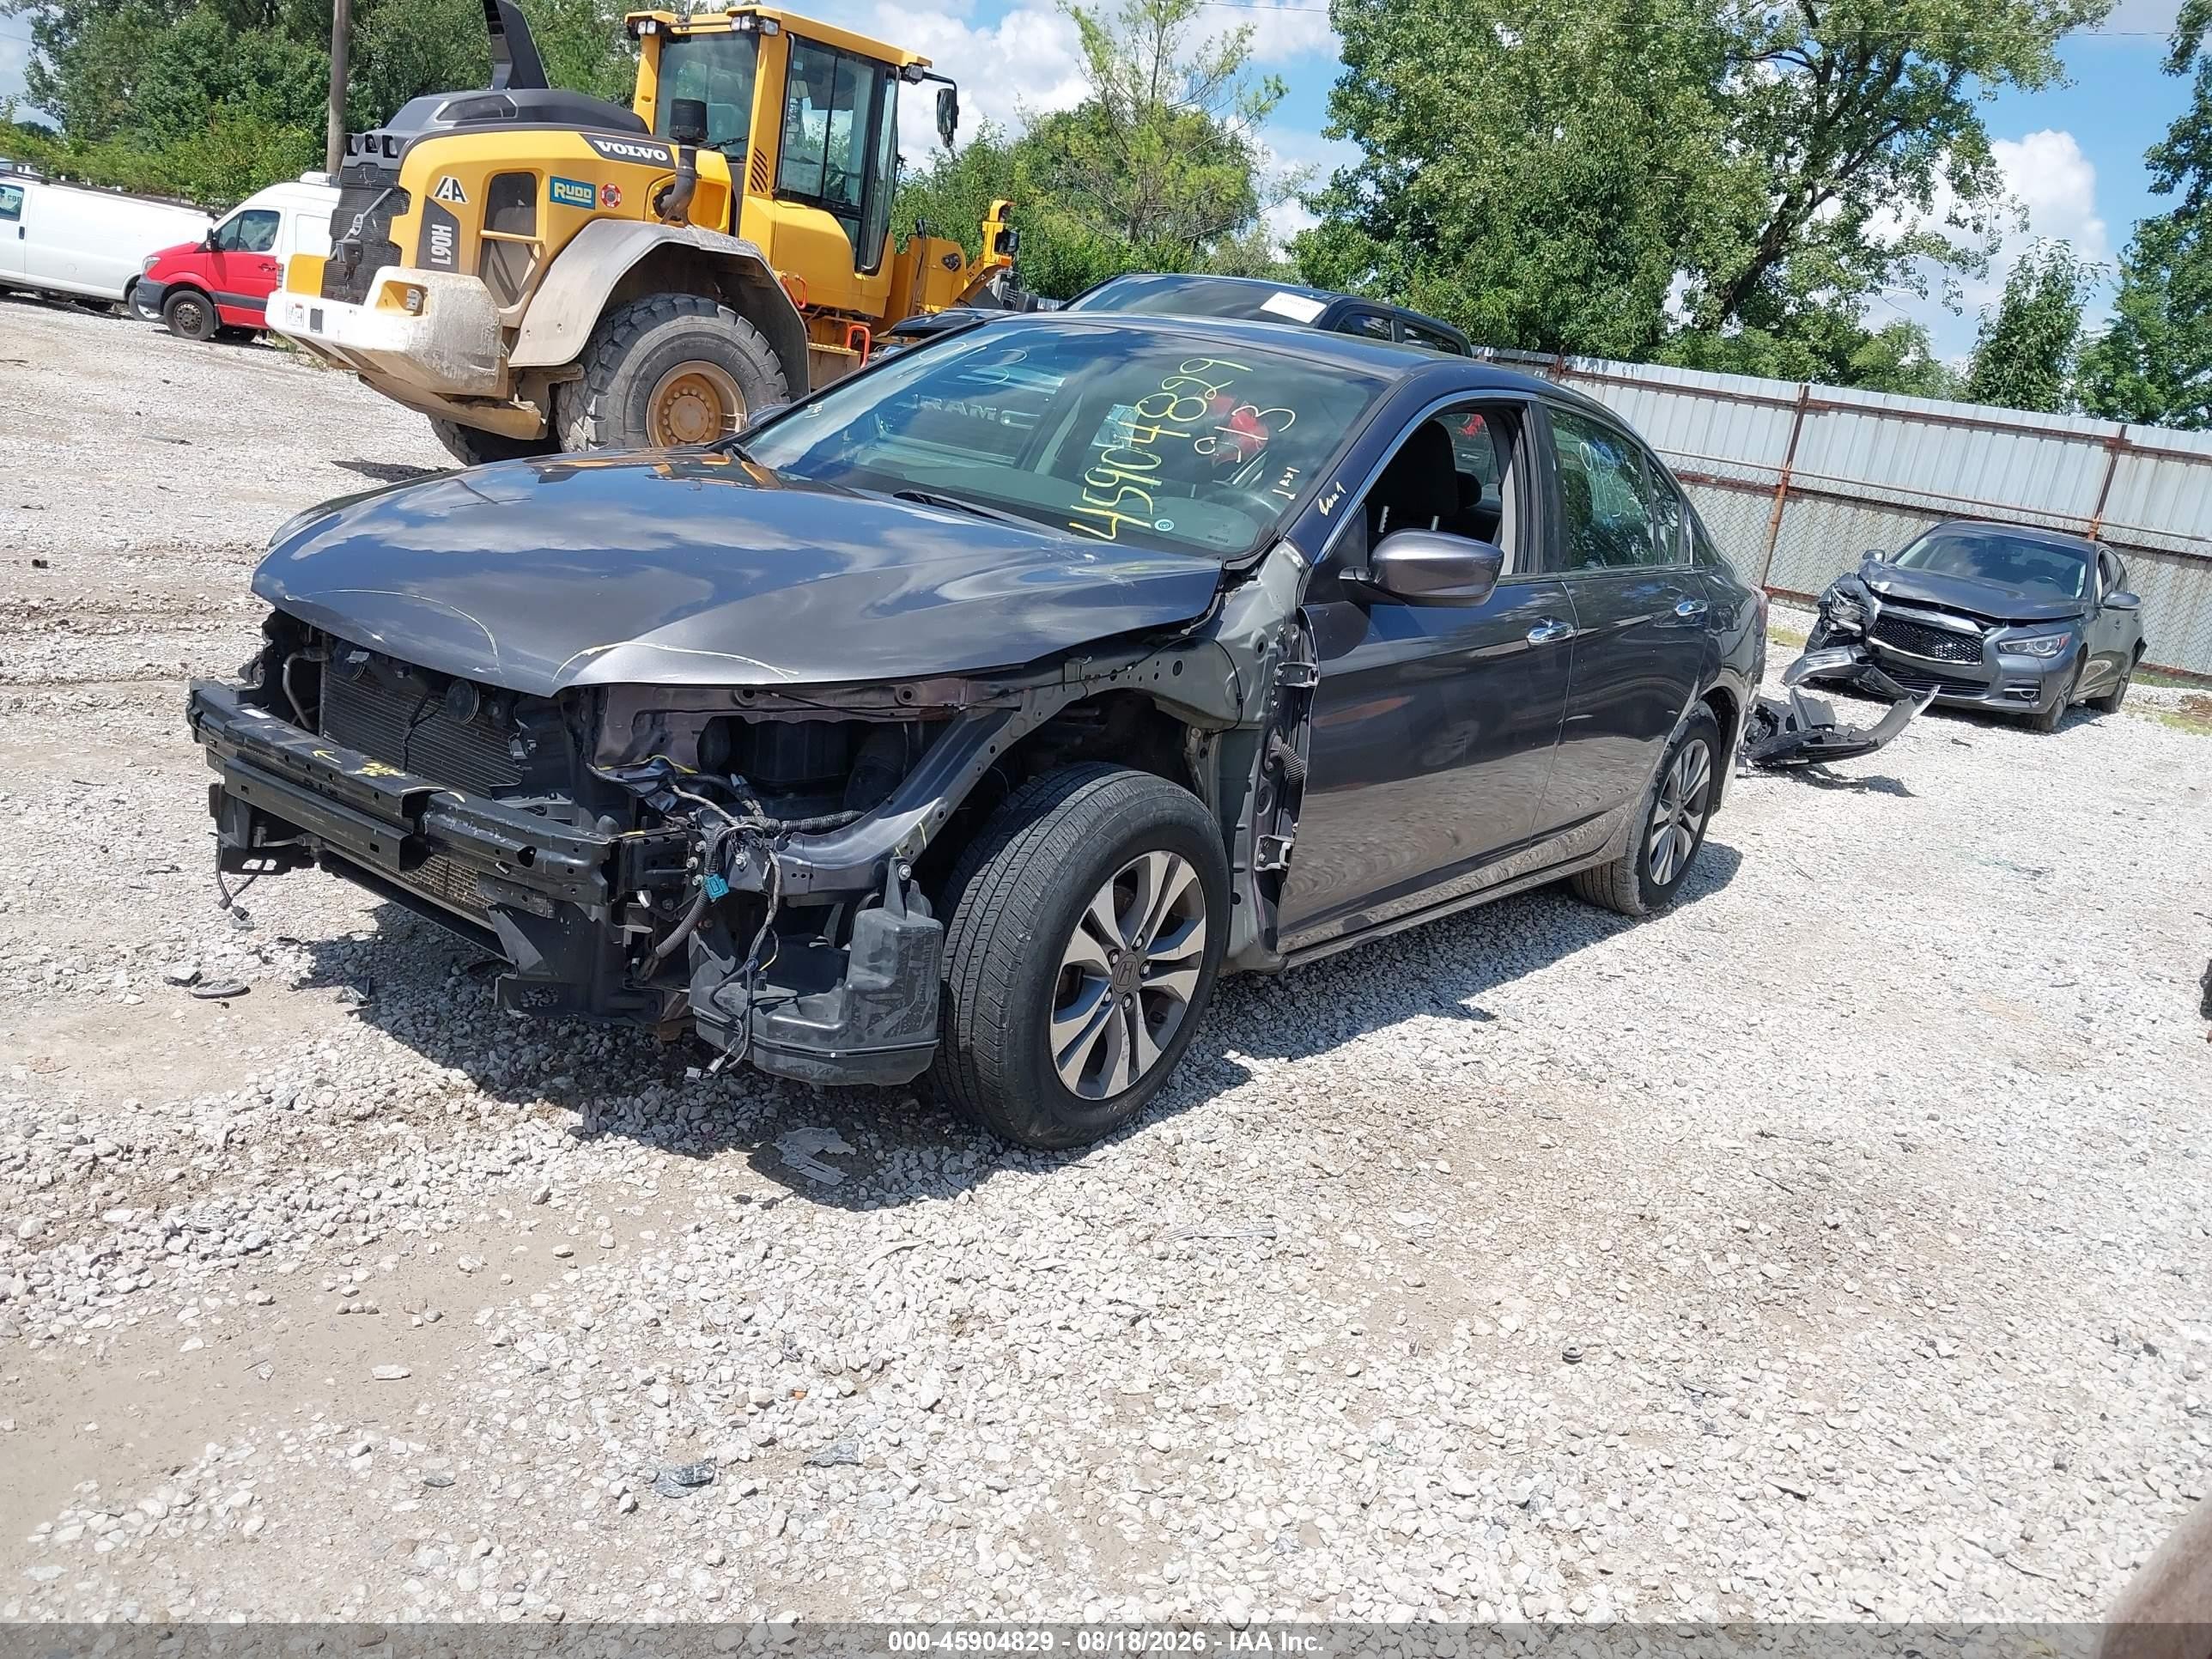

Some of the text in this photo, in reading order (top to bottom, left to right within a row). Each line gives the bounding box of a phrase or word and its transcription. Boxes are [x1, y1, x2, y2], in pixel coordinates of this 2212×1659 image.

[593, 140, 668, 161] VOLVO
[554, 182, 592, 200] RUDD
[431, 224, 452, 265] L90H
[1068, 358, 1253, 540] 45904829
[1194, 405, 1296, 463] 913
